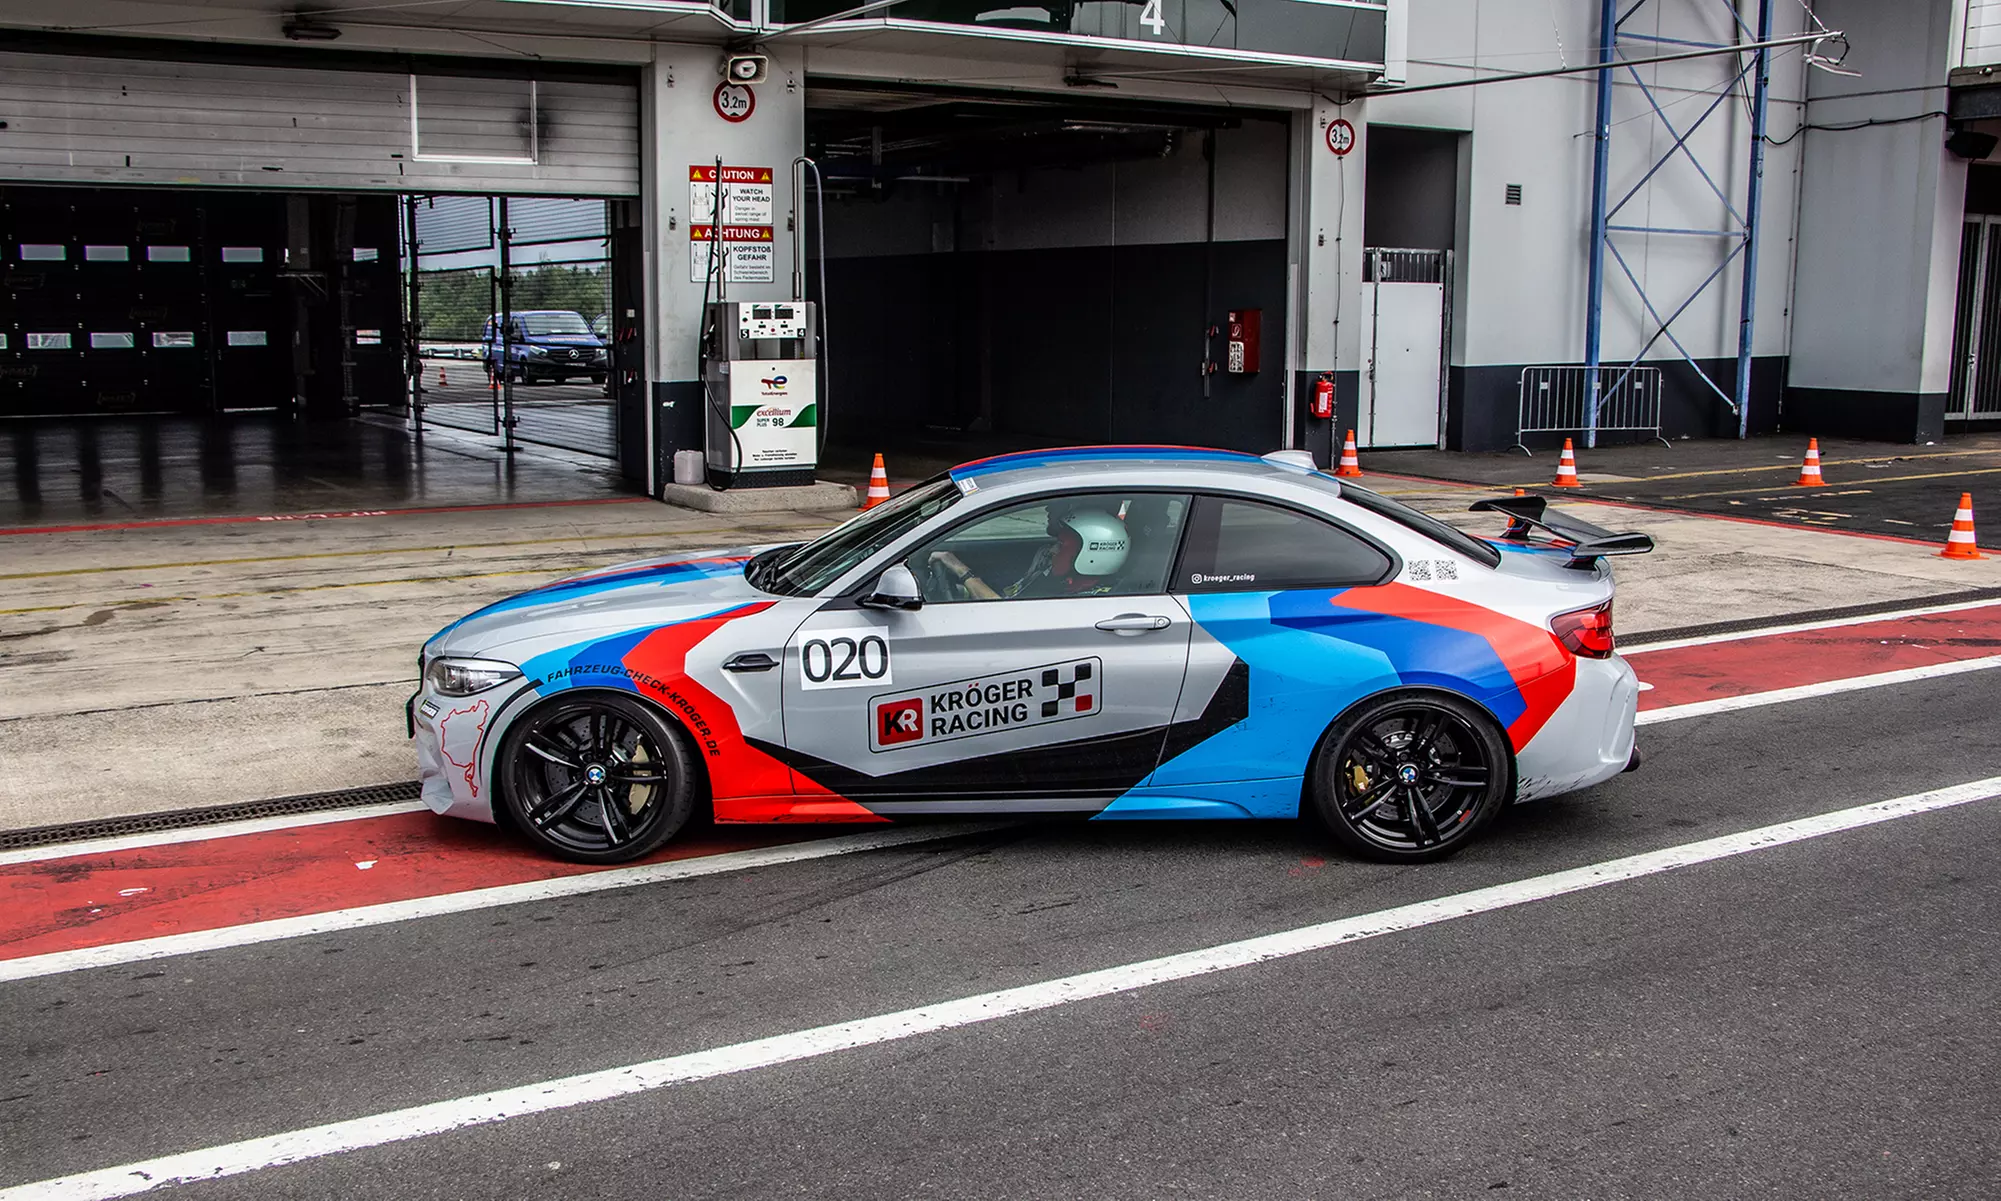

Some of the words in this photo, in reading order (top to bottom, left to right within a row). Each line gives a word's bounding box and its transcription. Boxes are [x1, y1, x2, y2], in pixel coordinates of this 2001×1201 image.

[1140, 0, 1165, 35] 4
[721, 90, 747, 108] 3.2m
[709, 169, 754, 180] CUTION
[798, 329, 804, 337] 4
[757, 407, 791, 416] excellium
[772, 417, 784, 427] 98
[1203, 573, 1255, 583] kroeger_racing
[802, 635, 888, 683] 020
[930, 682, 1034, 714] KRÖGER
[547, 664, 721, 757] FAHRZEUG-CHECK-KRÖGER.DE
[931, 703, 1028, 737] RACING
[884, 709, 918, 736] KR
